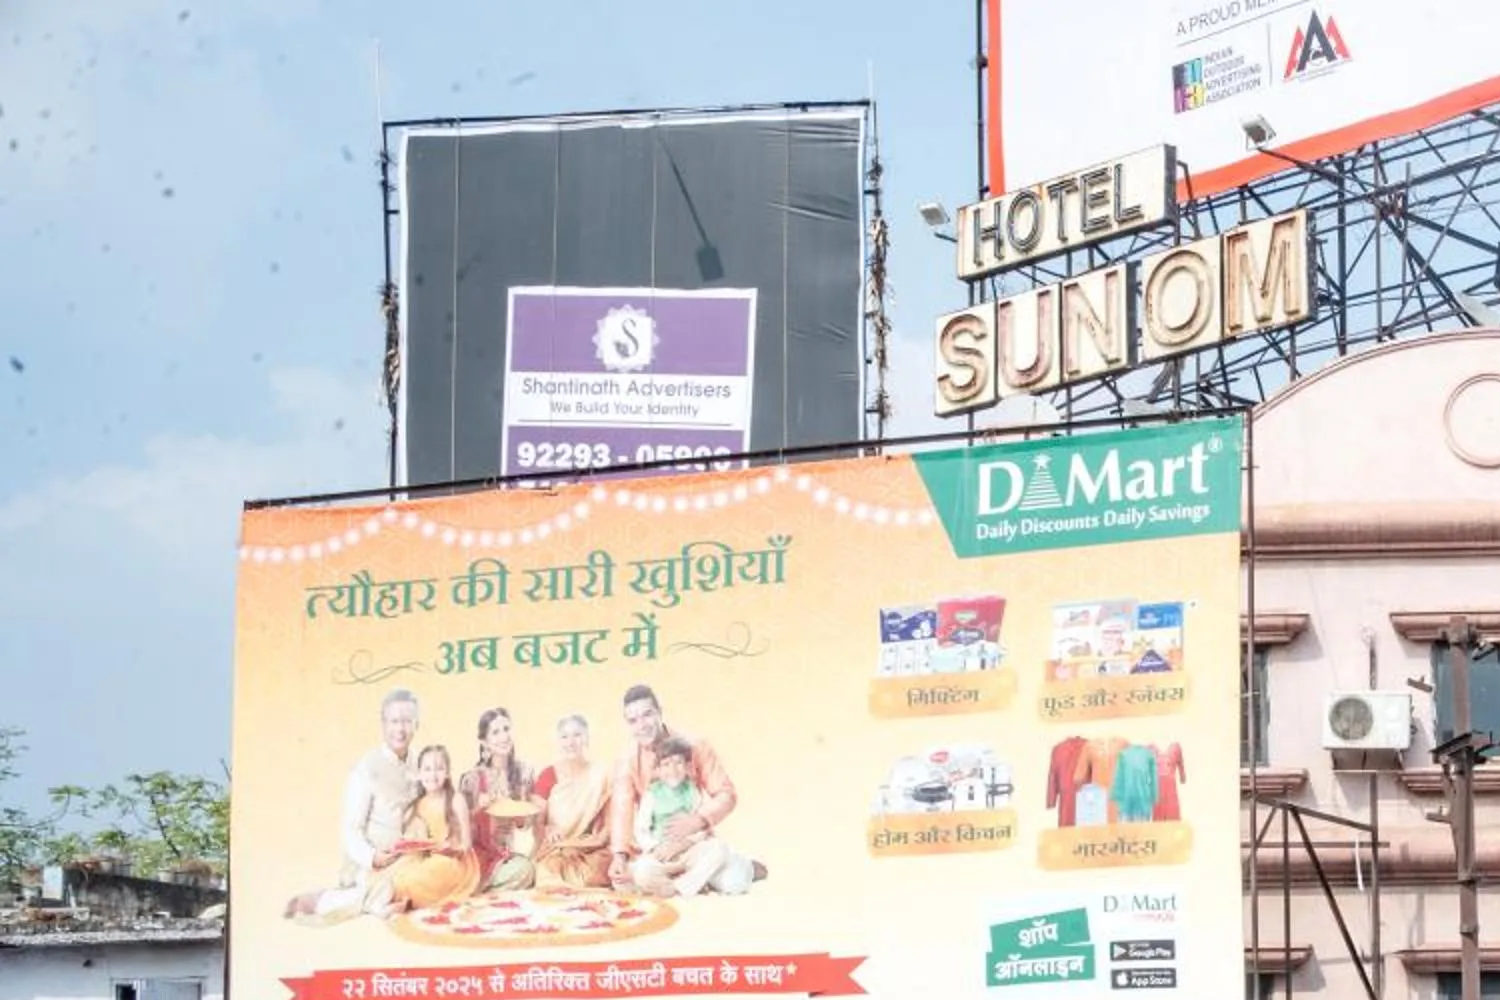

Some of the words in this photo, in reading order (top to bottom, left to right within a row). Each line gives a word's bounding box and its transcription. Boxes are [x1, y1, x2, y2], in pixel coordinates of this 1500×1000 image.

[1188, 1, 1241, 31] PROUD
[1206, 77, 1262, 104] ASSOCIATION
[971, 163, 1144, 265] HOTEL
[521, 377, 620, 397] Shantinath
[625, 379, 732, 399] Advertisers
[550, 402, 572, 415] We
[575, 402, 610, 415] Build
[614, 403, 643, 416] Your
[647, 403, 700, 418] Identity
[517, 441, 611, 469] 92293
[975, 521, 1017, 542] Daily
[1020, 513, 1100, 536] Discounts
[1103, 507, 1146, 529] Daily
[1148, 502, 1211, 524] Savings
[305, 569, 439, 620] त्यौहार
[450, 556, 512, 608] की
[523, 548, 617, 602] सारी
[628, 534, 794, 607] खुशियाँ
[434, 635, 502, 675] अब
[512, 627, 611, 667] बजट
[622, 612, 661, 662] में
[913, 826, 951, 845] और
[1018, 918, 1059, 949] शॉप
[342, 978, 365, 999] २२
[371, 971, 430, 998] सितंबर
[434, 975, 484, 996] २०२५
[488, 968, 506, 992] से
[511, 965, 590, 992] अतिरिक्त
[595, 960, 666, 992] जीएसटी
[671, 966, 714, 986] बचत
[719, 960, 739, 985] के
[994, 952, 1088, 979] ऑनलाइन
[1131, 975, 1149, 987] App
